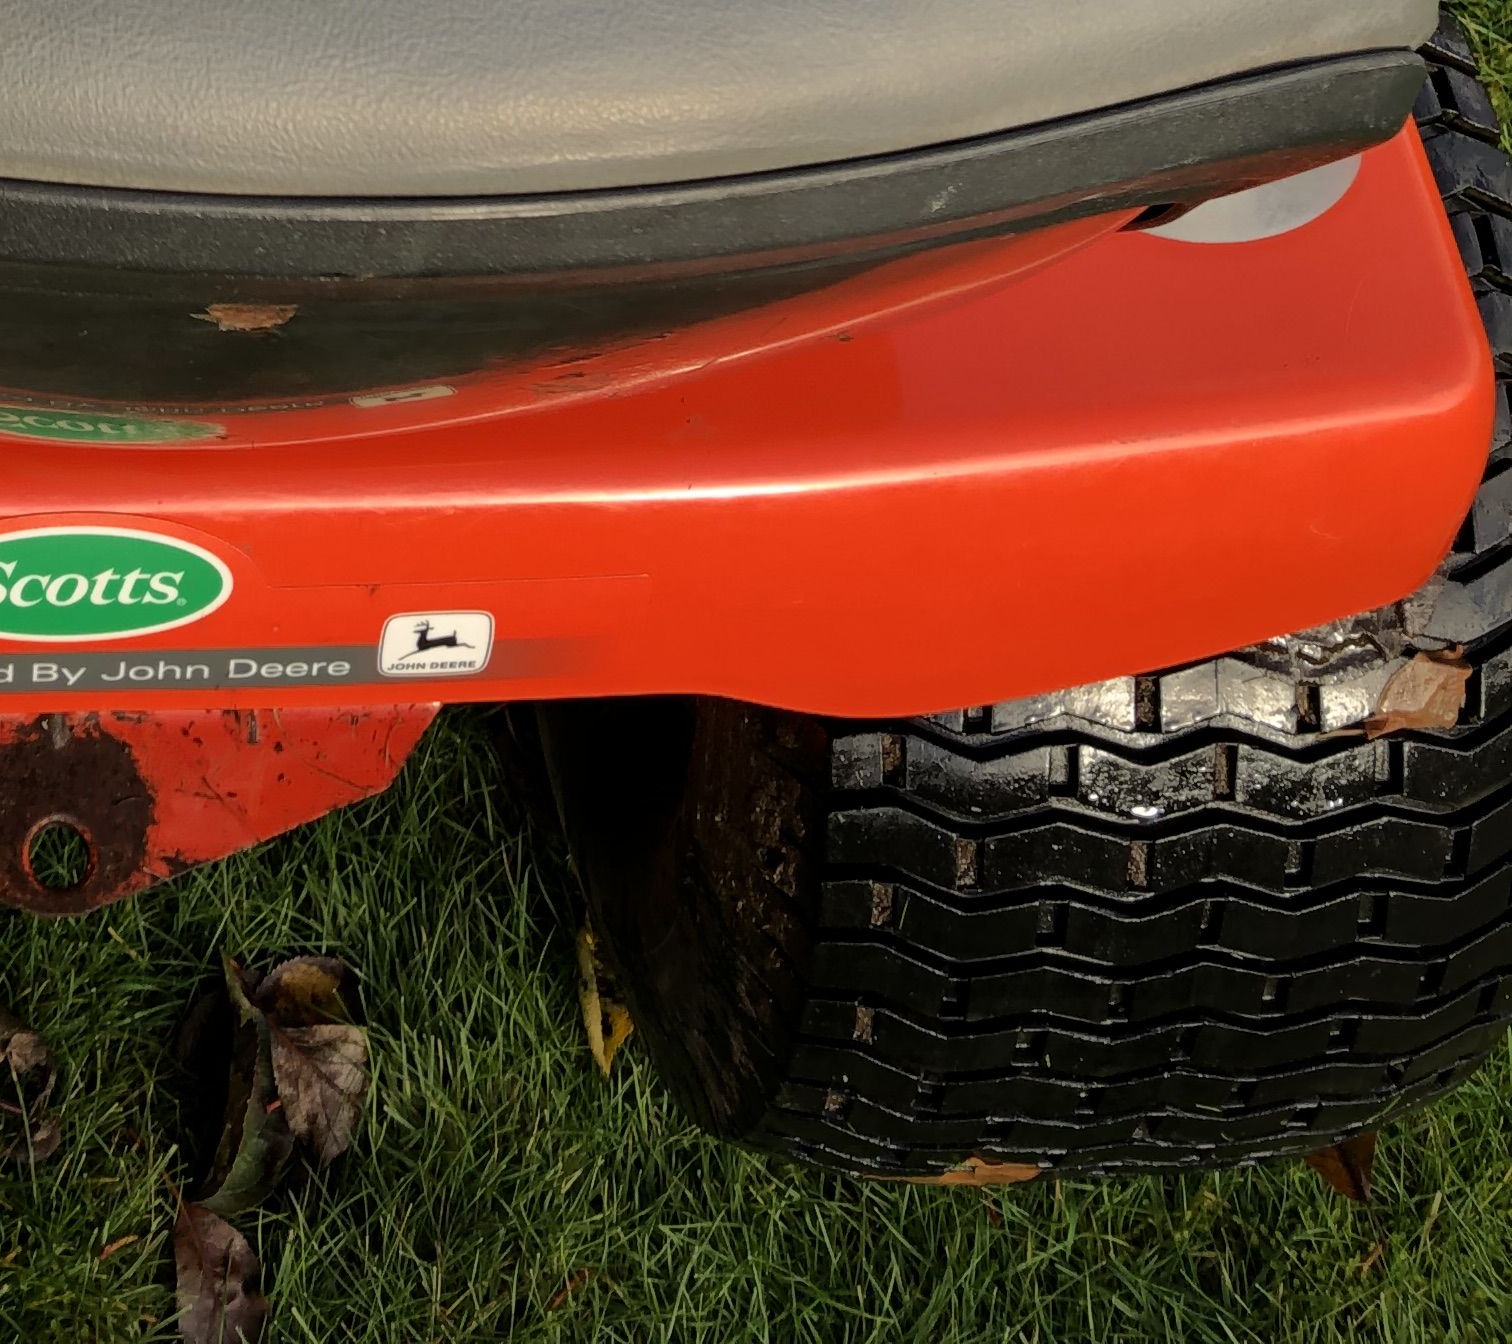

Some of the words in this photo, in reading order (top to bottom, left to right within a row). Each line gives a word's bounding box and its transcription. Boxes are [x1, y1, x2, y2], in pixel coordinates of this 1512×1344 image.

[32, 663, 87, 690] By
[100, 660, 212, 683] John
[229, 656, 350, 679] Deere
[387, 661, 426, 673] JOHN
[430, 659, 477, 671] DEERE
